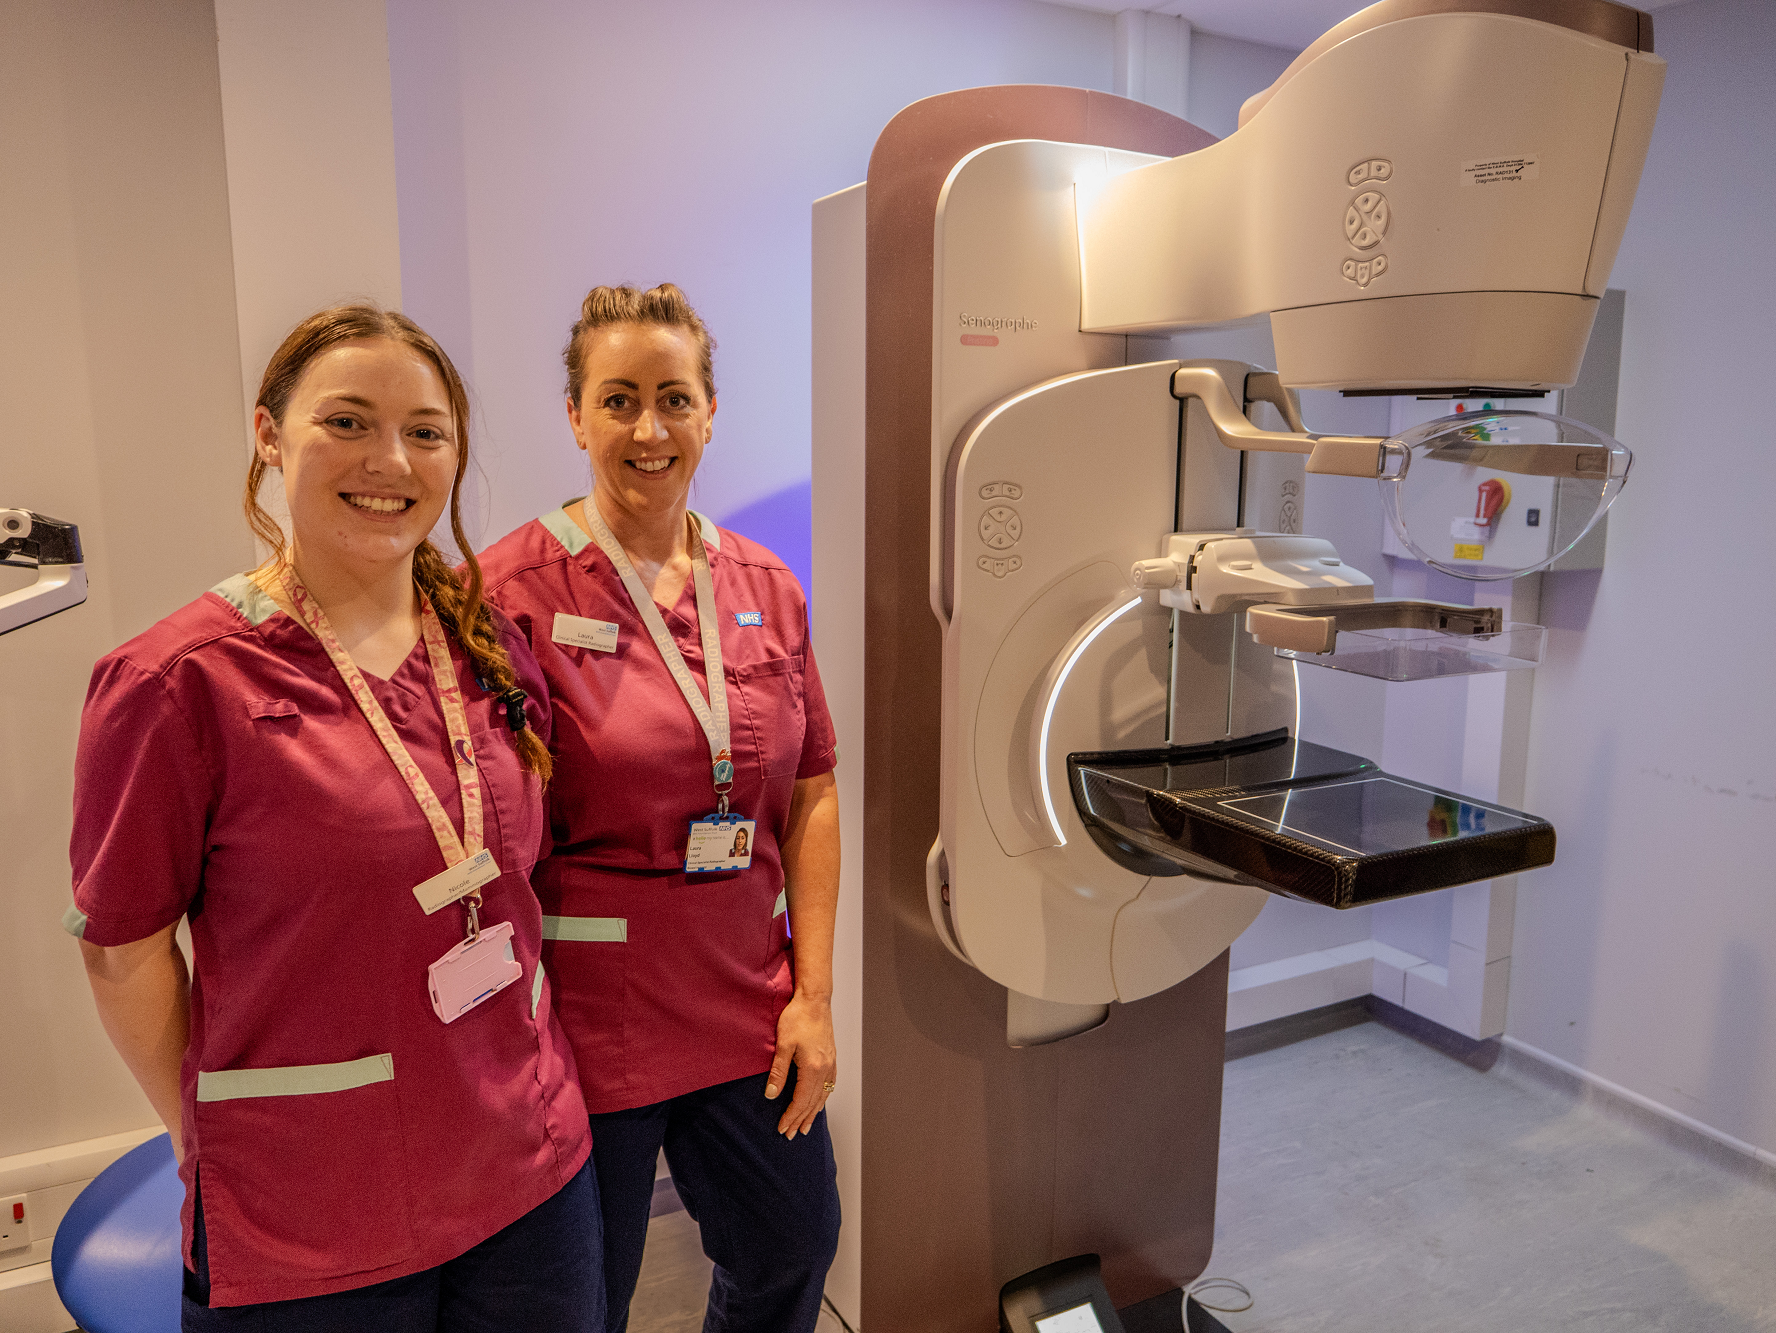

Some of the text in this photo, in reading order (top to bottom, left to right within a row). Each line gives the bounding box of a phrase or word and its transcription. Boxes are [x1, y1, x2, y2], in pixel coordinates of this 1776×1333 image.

[959, 312, 1039, 333] Senographe
[739, 613, 760, 625] NHS
[577, 632, 594, 640] Laura
[588, 641, 614, 649] Radiographer
[656, 632, 719, 741] RADIOGRAPHER
[448, 879, 471, 894] Nicole
